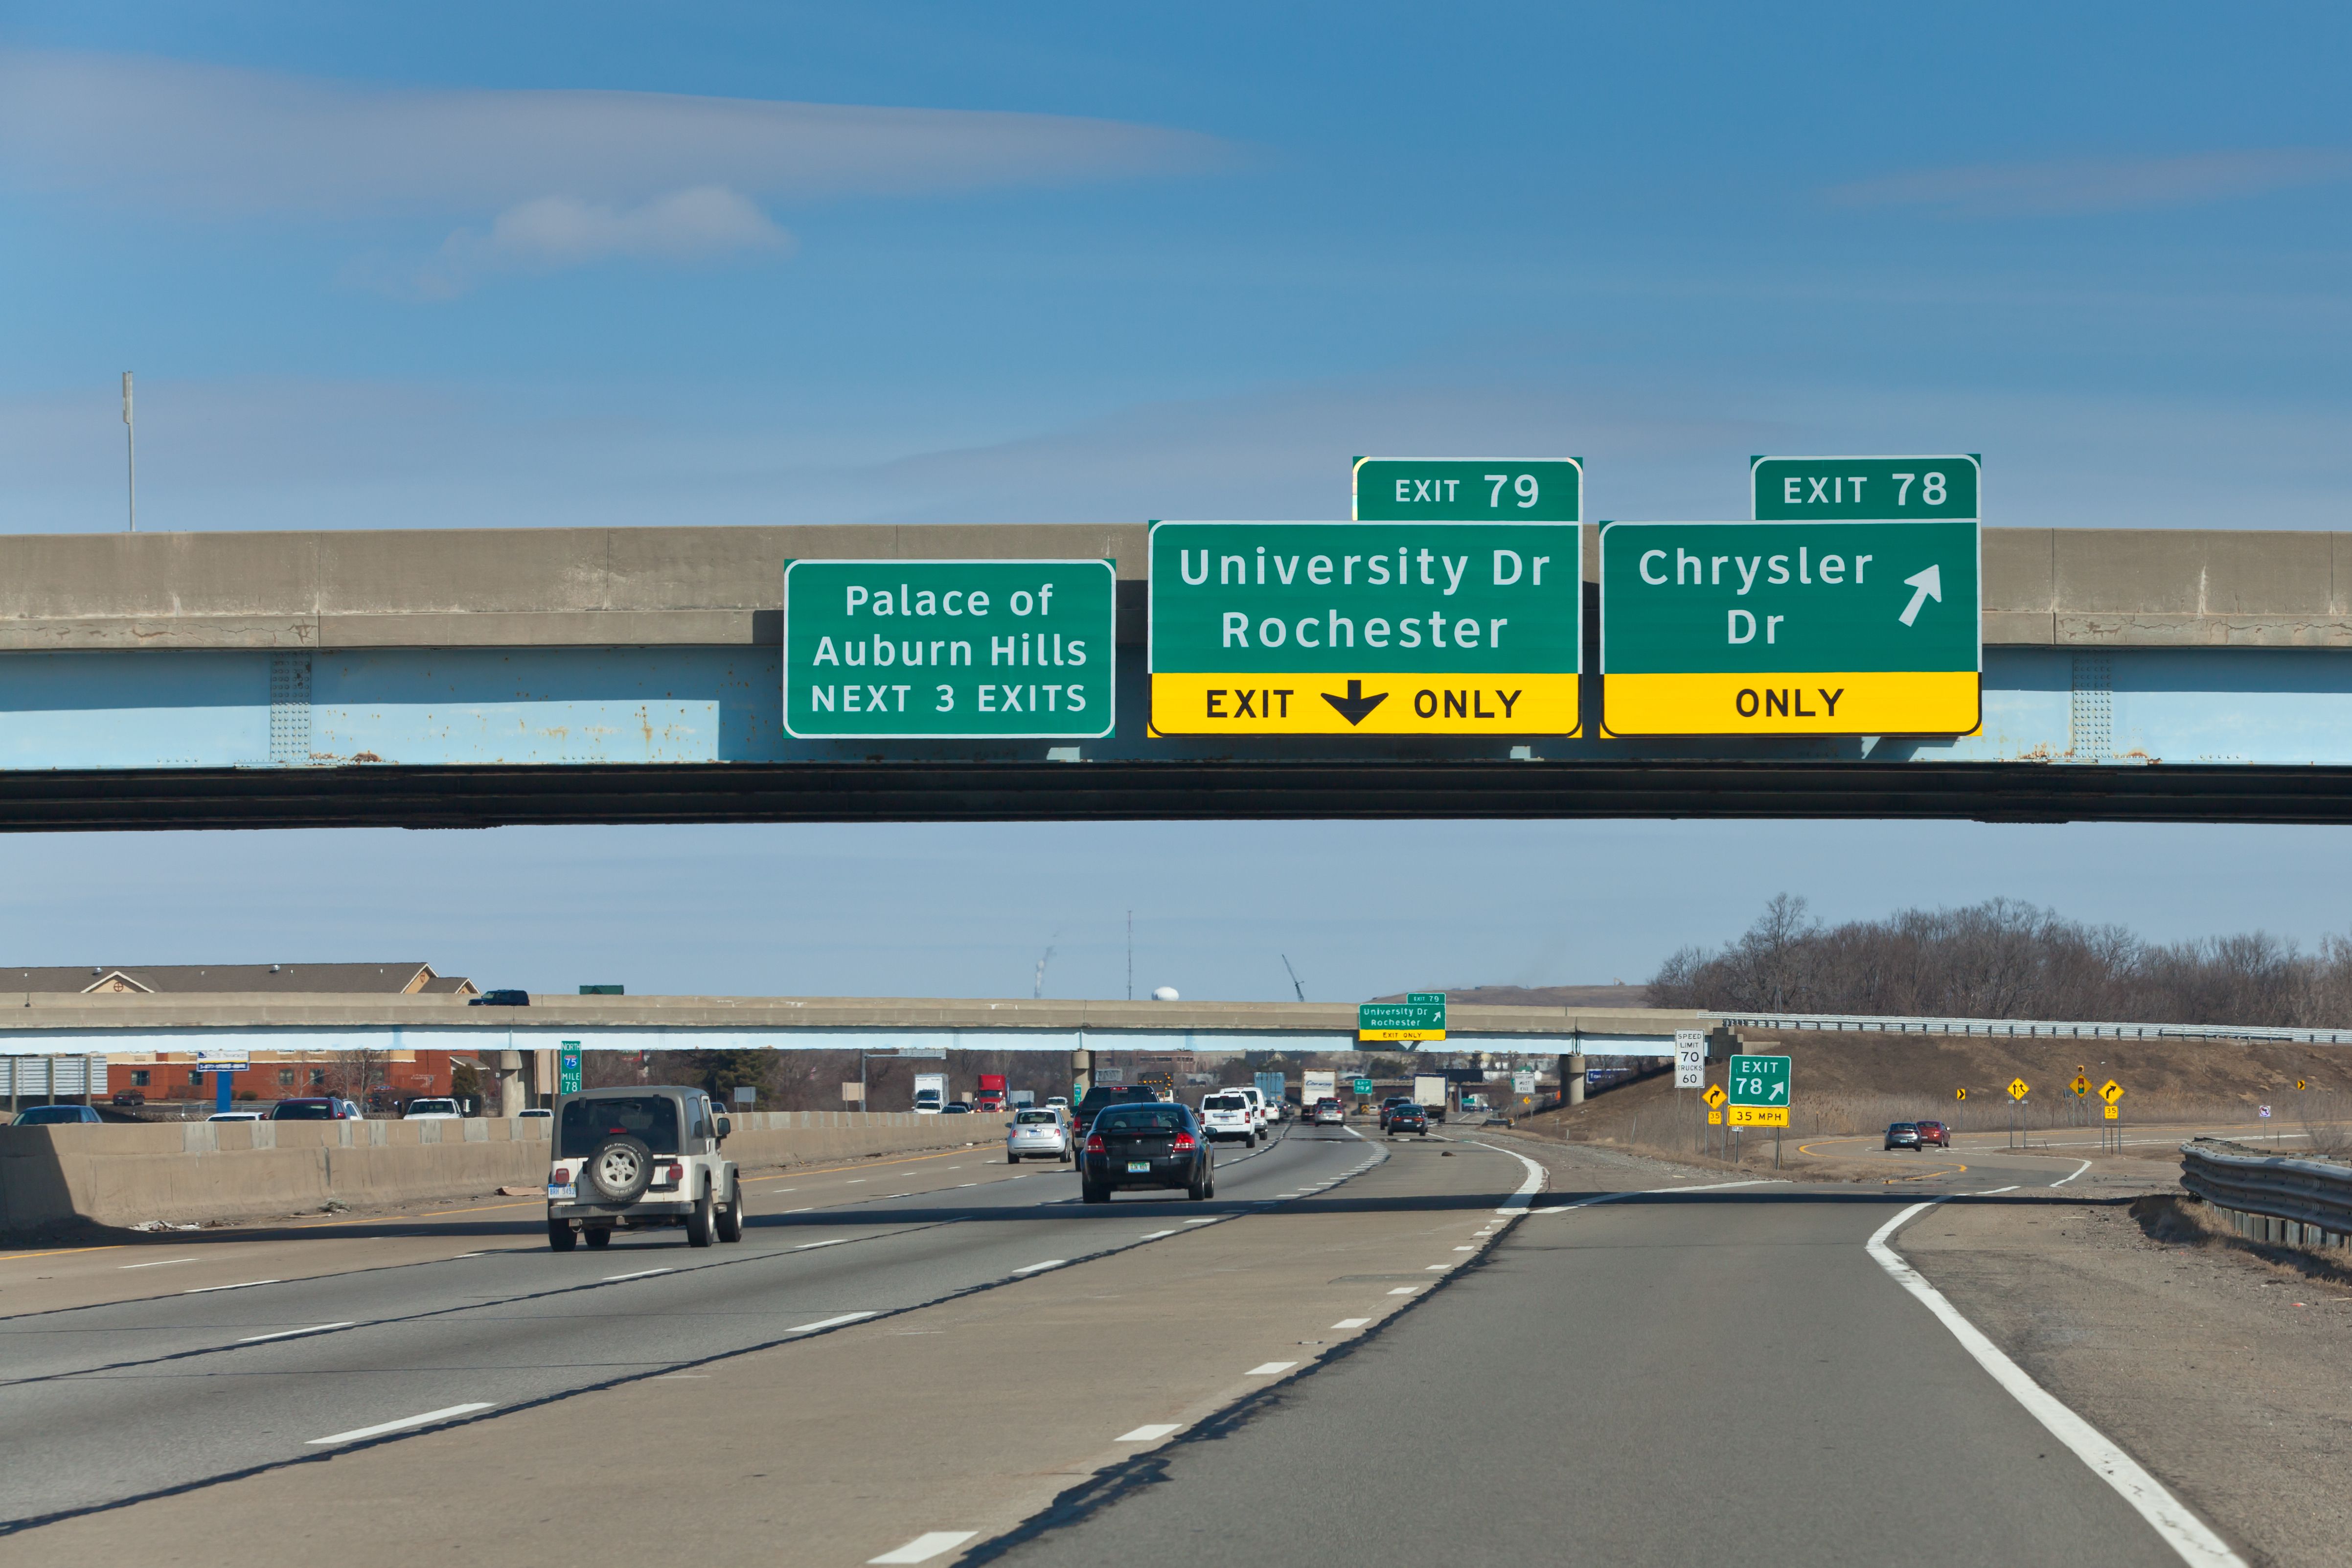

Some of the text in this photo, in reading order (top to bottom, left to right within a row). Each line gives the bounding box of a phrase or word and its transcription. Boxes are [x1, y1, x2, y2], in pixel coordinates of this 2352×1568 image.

[1396, 475, 1538, 508] EXIT 79
[1784, 472, 1946, 505] EXIT 78
[1181, 546, 1549, 595] University Dr
[1640, 547, 1872, 595] Chrysler
[847, 584, 1052, 615] Palace of
[1223, 610, 1507, 648] Rochester
[1728, 610, 1783, 643] Dr
[813, 633, 1086, 666] Auburn Hills
[813, 684, 1085, 711] NEXT 3 EXITS
[1207, 690, 1522, 718] EXIT ONLY
[1736, 689, 1844, 717] ONLY
[1364, 1008, 1413, 1016] University
[562, 1042, 581, 1051] NORTH
[1681, 1052, 1699, 1062] 70
[565, 1058, 577, 1067] 75
[1742, 1062, 1778, 1072] EXIT
[565, 1081, 578, 1092] 78
[1683, 1074, 1697, 1083] 60
[1736, 1078, 1761, 1094] 78
[1737, 1112, 1752, 1120] 35
